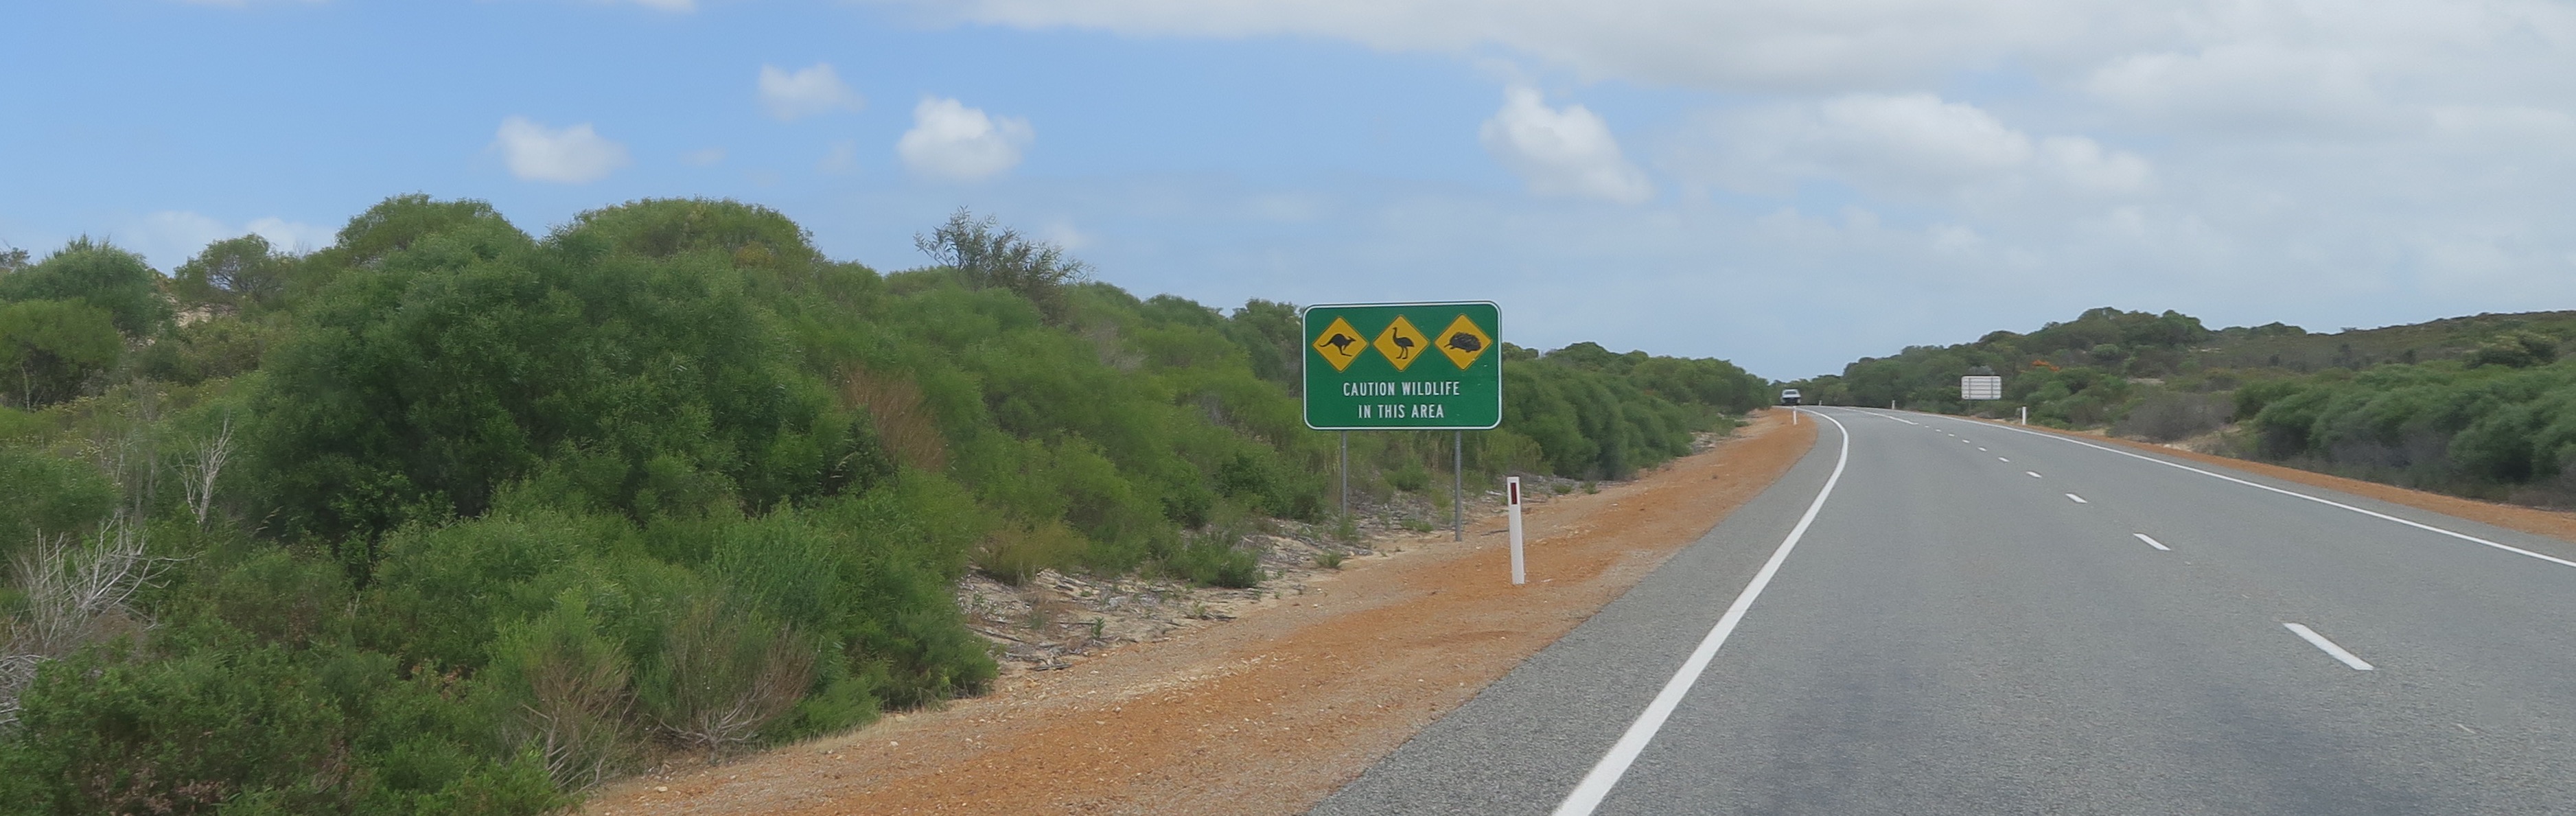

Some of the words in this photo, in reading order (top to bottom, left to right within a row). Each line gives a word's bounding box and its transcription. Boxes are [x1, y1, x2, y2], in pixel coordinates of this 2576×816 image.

[1343, 382, 1395, 397] CAUTION
[1402, 382, 1460, 396] WILDLIFE
[1358, 404, 1371, 419] IN
[1378, 404, 1405, 419] THIS
[1411, 404, 1444, 419] AREA
